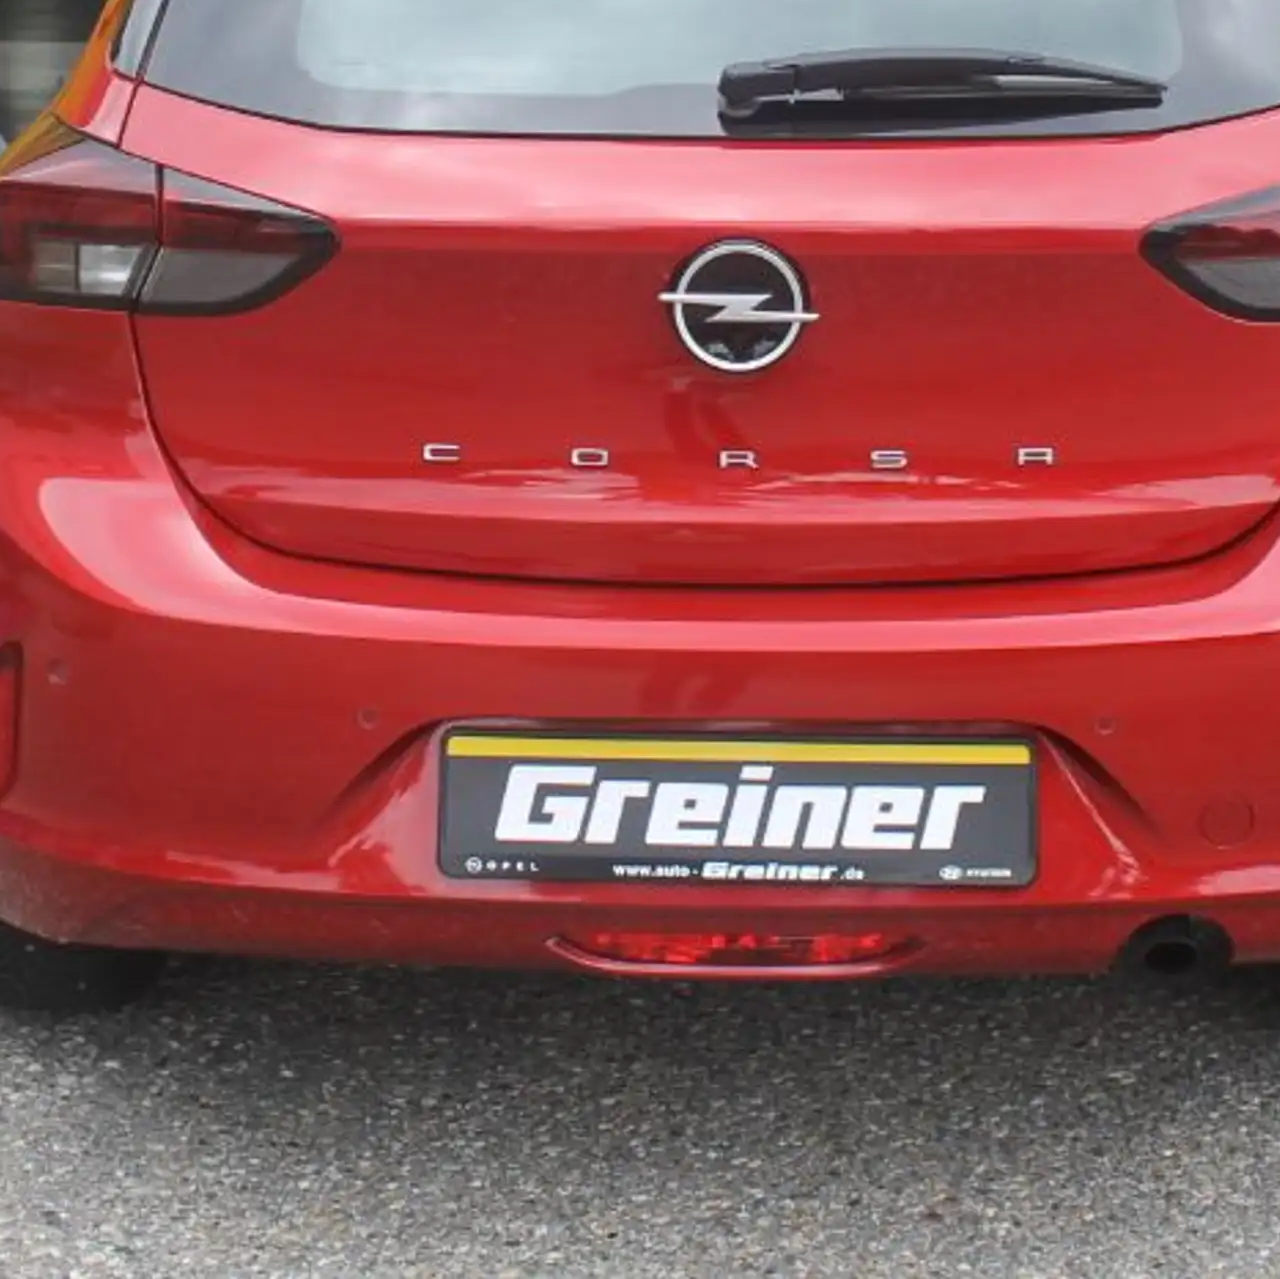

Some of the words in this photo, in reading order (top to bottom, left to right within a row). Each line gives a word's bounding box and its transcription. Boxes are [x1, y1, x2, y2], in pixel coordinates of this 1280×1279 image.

[423, 442, 1055, 470] CORSA
[494, 763, 987, 850] Greiner
[486, 859, 540, 872] OPEL
